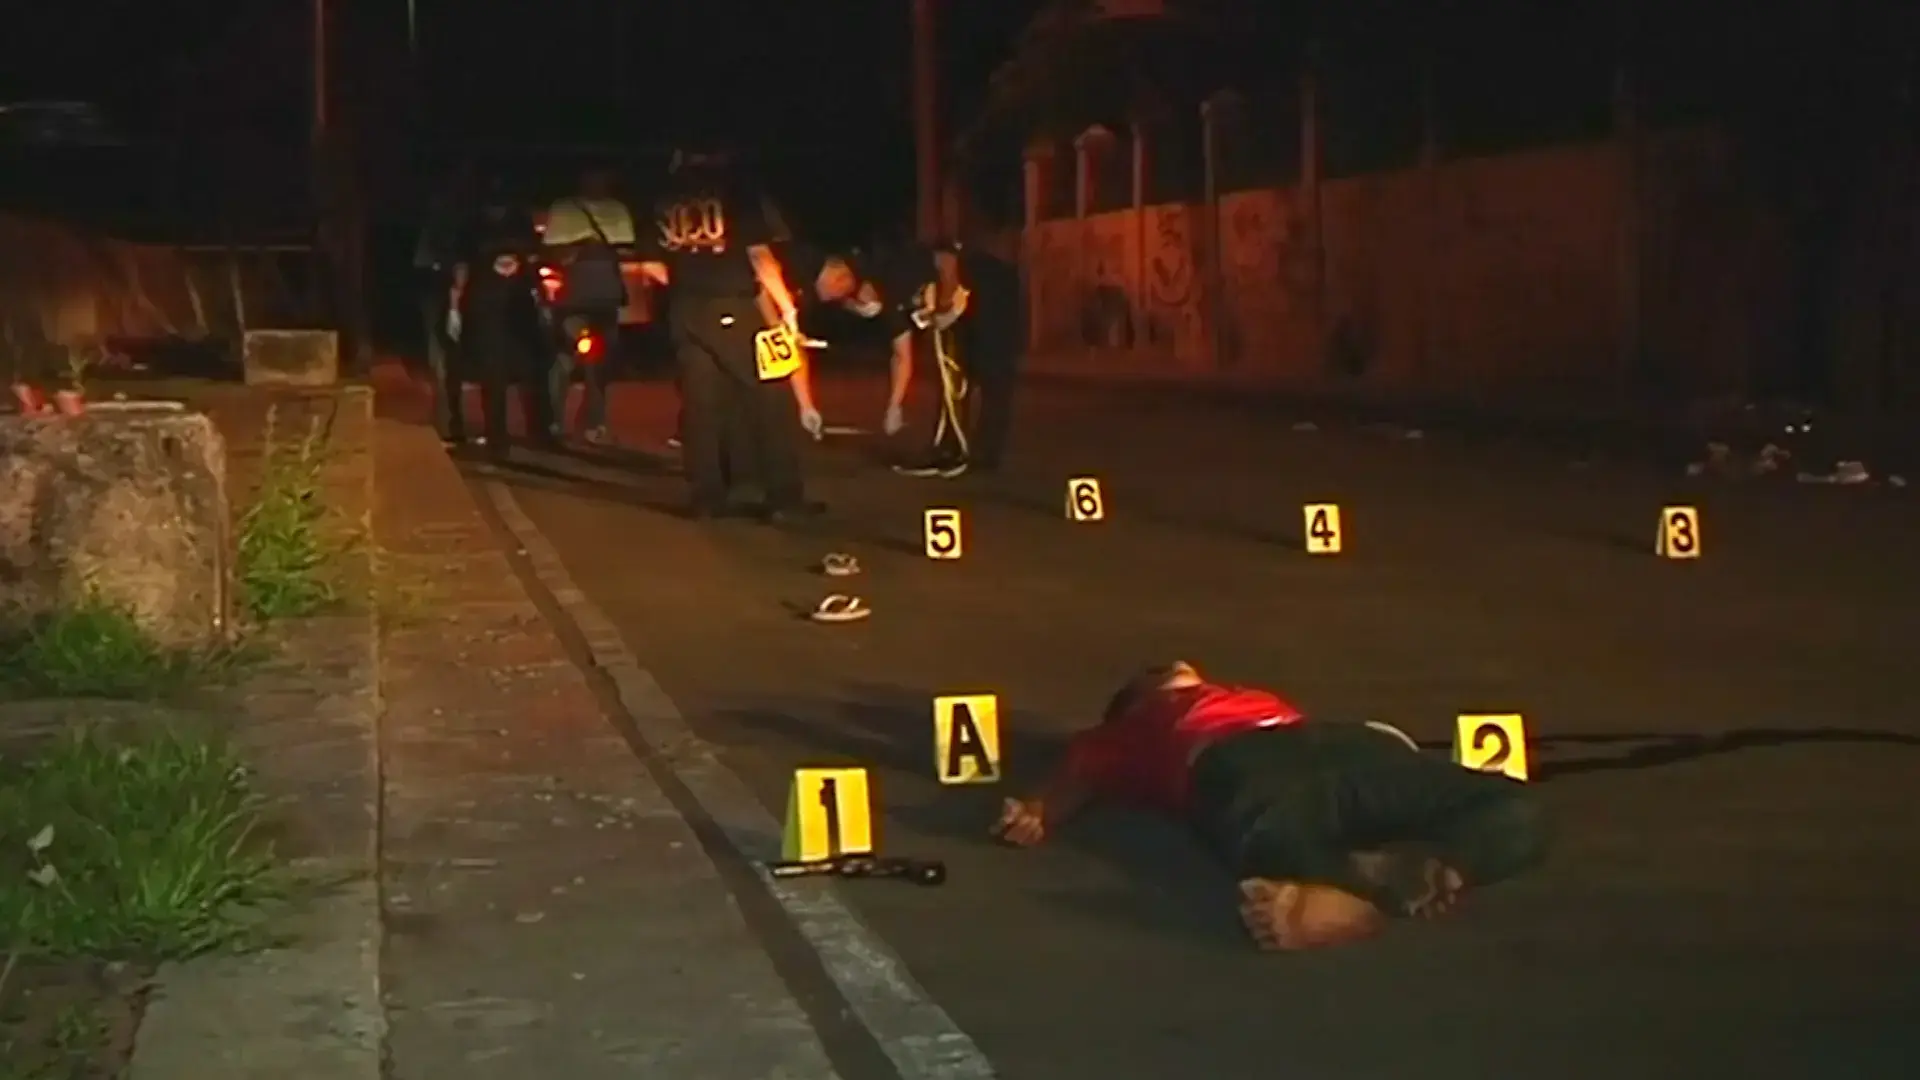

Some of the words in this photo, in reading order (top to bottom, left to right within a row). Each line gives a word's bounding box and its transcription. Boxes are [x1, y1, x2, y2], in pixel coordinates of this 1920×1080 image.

[762, 331, 792, 363] 15
[1075, 483, 1098, 517] 6
[931, 514, 957, 552] 5
[1310, 508, 1336, 548] 4
[1669, 512, 1694, 553] 3
[945, 702, 993, 778] A
[1473, 722, 1511, 769] 2
[819, 777, 841, 856] 1
